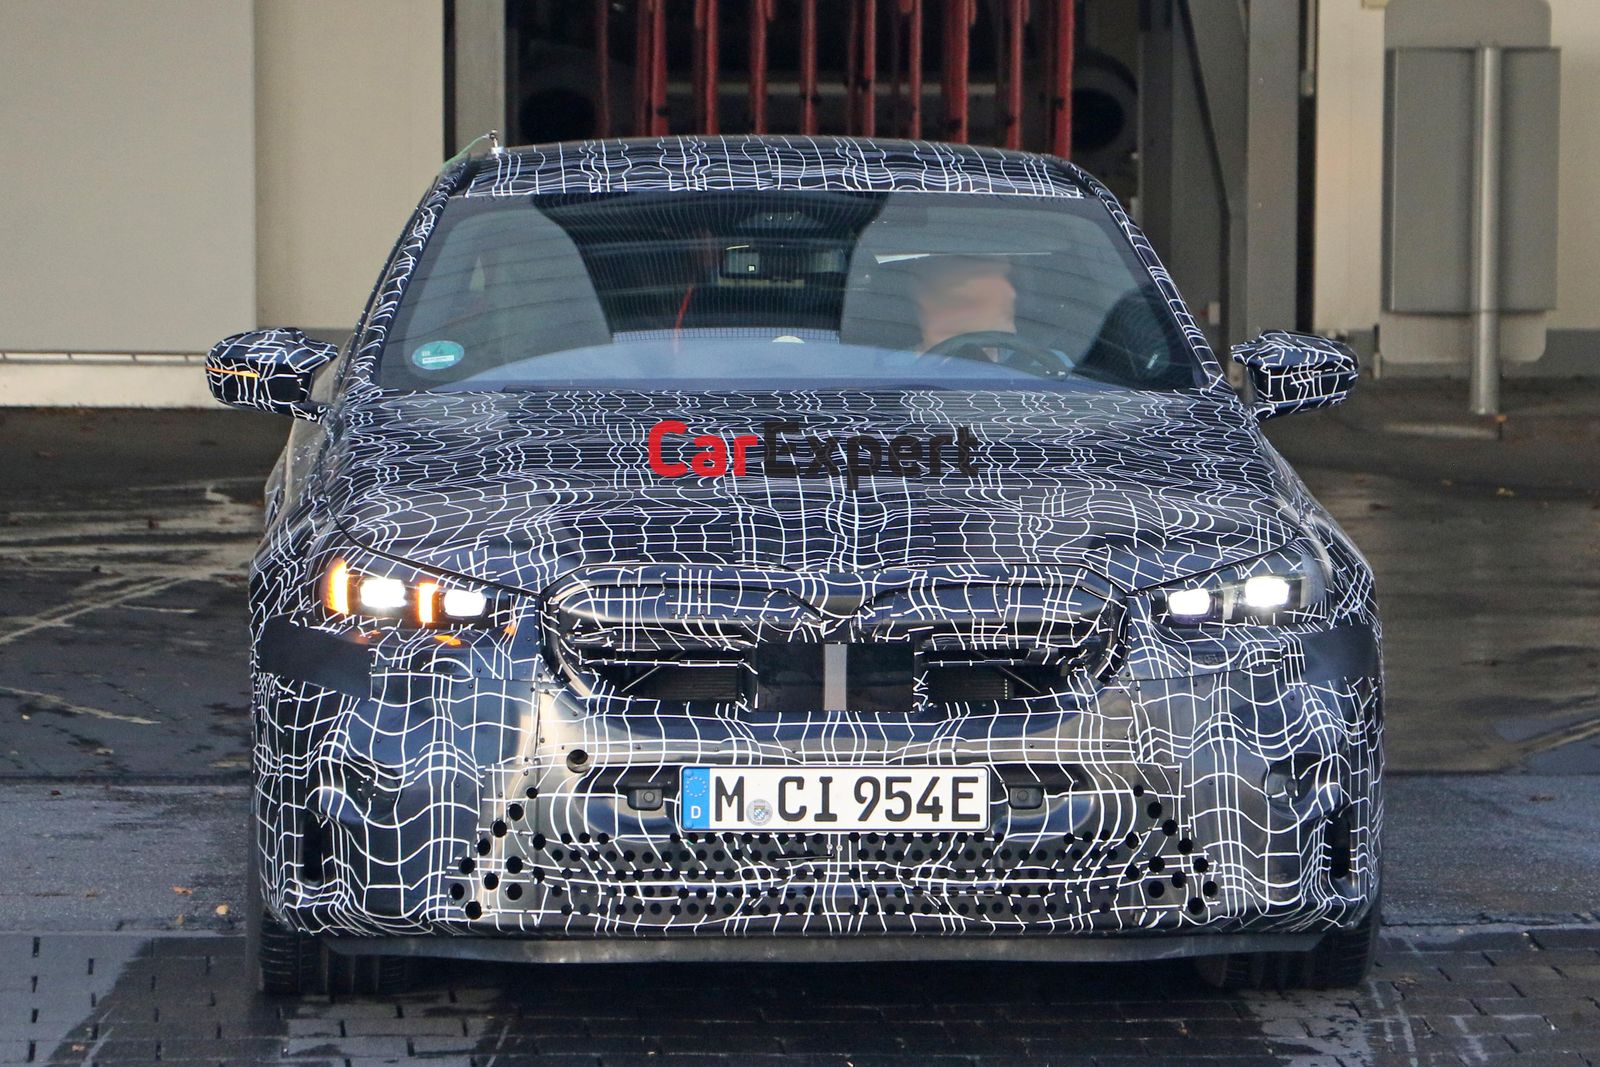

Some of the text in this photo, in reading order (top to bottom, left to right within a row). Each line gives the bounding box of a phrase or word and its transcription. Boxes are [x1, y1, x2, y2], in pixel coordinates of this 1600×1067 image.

[690, 806, 701, 819] D
[715, 776, 981, 822] M CI 954E
